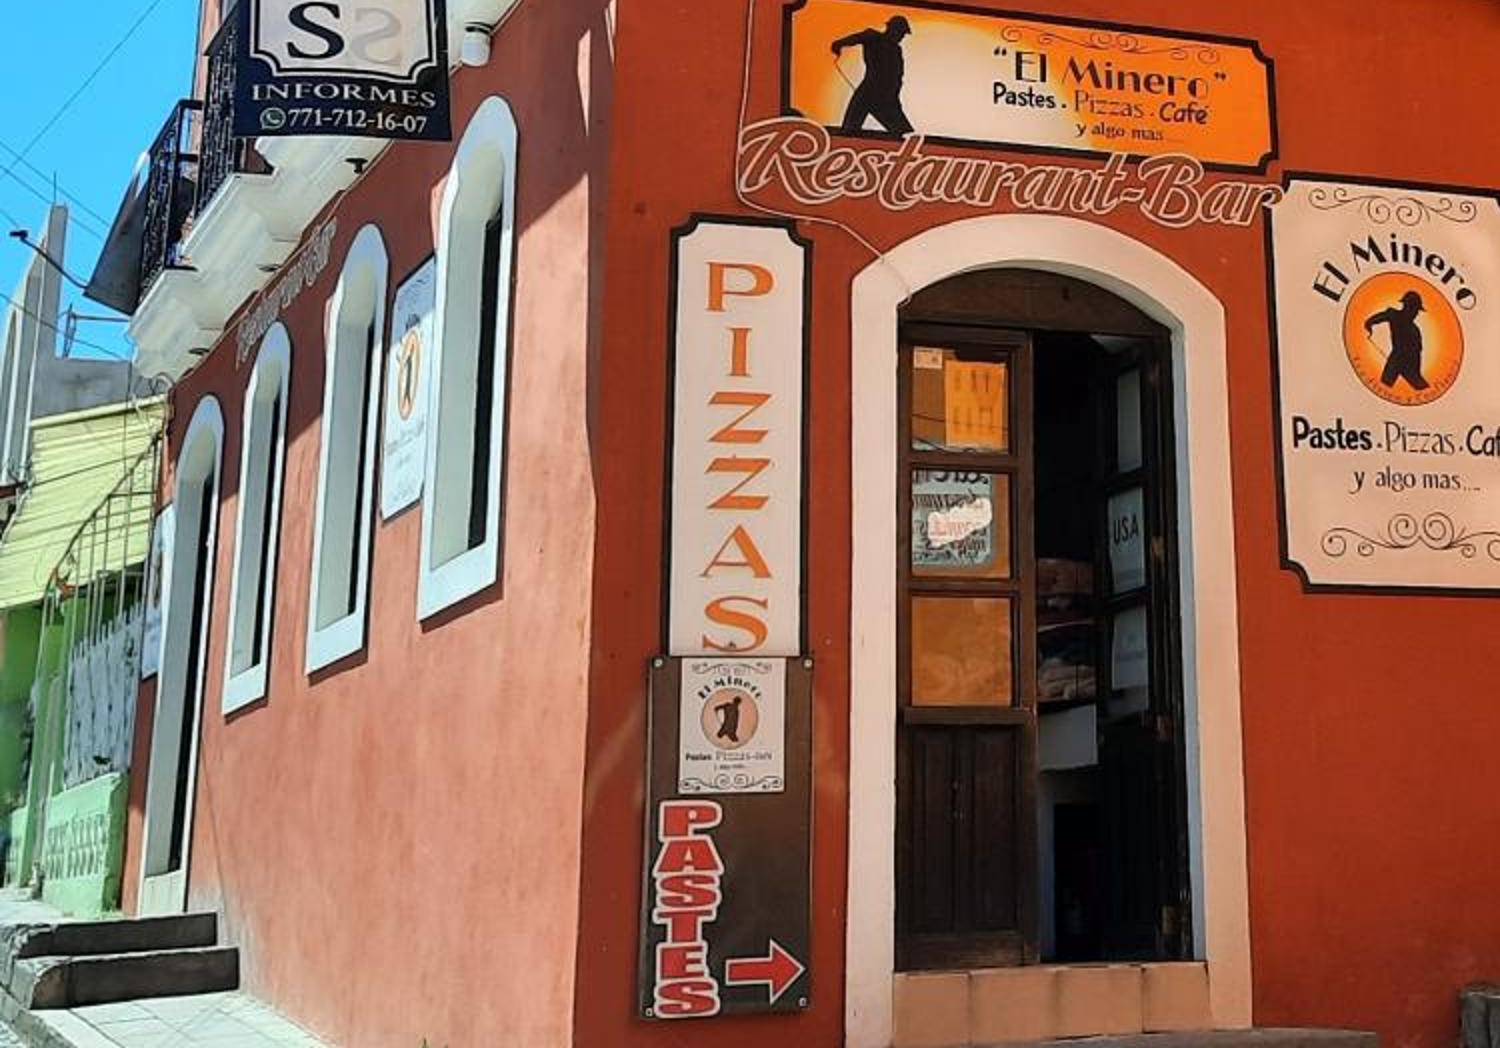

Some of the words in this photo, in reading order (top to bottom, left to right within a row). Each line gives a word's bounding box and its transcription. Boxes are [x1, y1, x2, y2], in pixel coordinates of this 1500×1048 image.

[252, 83, 437, 109] INFORMES
[288, 107, 428, 133] 771-712-16-07
[1074, 122, 1087, 138] y
[1091, 121, 1126, 140] algo
[737, 115, 1284, 229] Restaurant-Bar
[1312, 260, 1350, 304] El
[1350, 233, 1478, 312] Minero
[699, 261, 776, 653] PIZZAS
[1348, 469, 1366, 495] y
[1375, 466, 1416, 492] algo
[1112, 513, 1140, 545] USA
[653, 800, 725, 1019] PASTES
